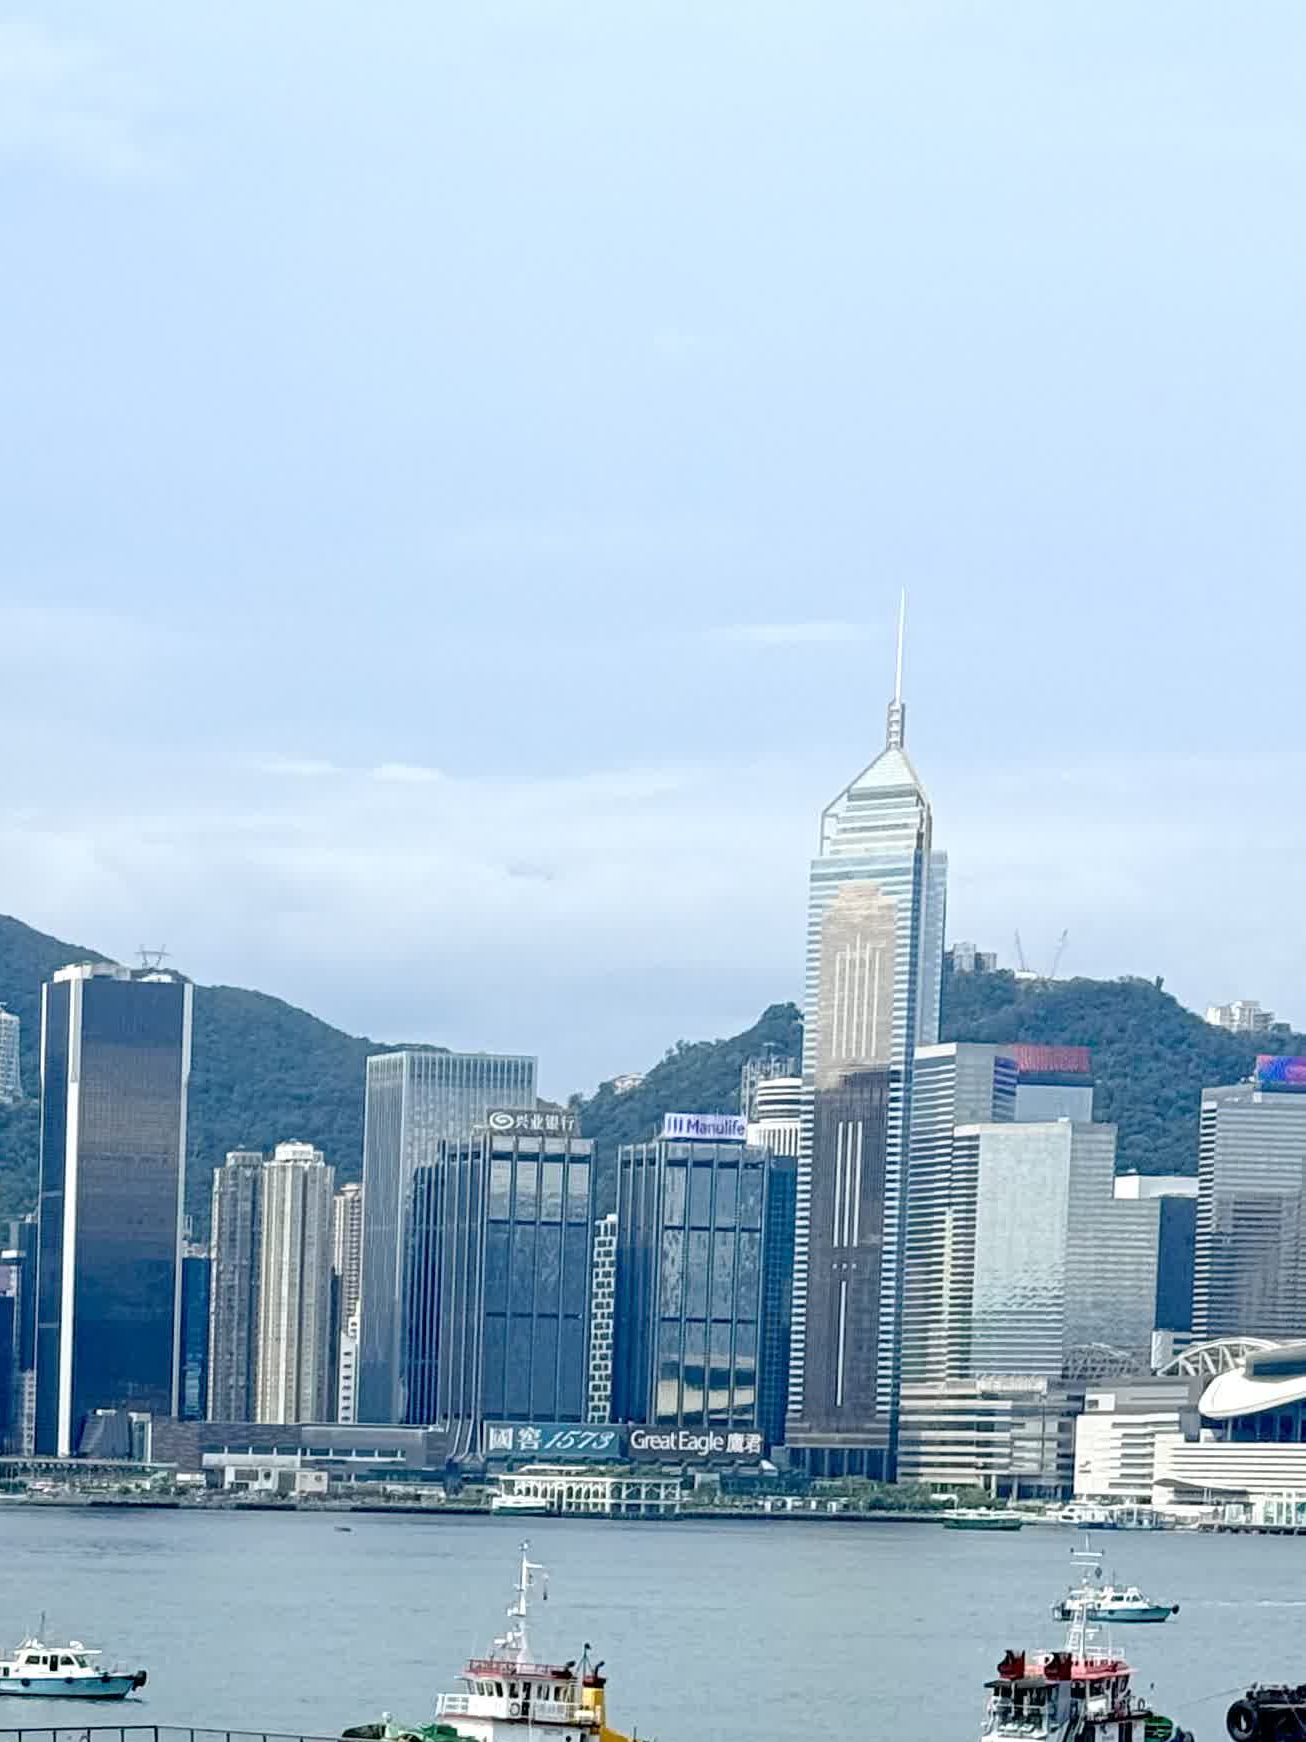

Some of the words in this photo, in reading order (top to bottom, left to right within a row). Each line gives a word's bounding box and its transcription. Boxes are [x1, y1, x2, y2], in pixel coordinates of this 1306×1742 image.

[515, 1114, 575, 1131] 兴业银行
[686, 1118, 745, 1137] Manulife
[630, 1430, 676, 1450] Great
[678, 1430, 724, 1456] Eagle
